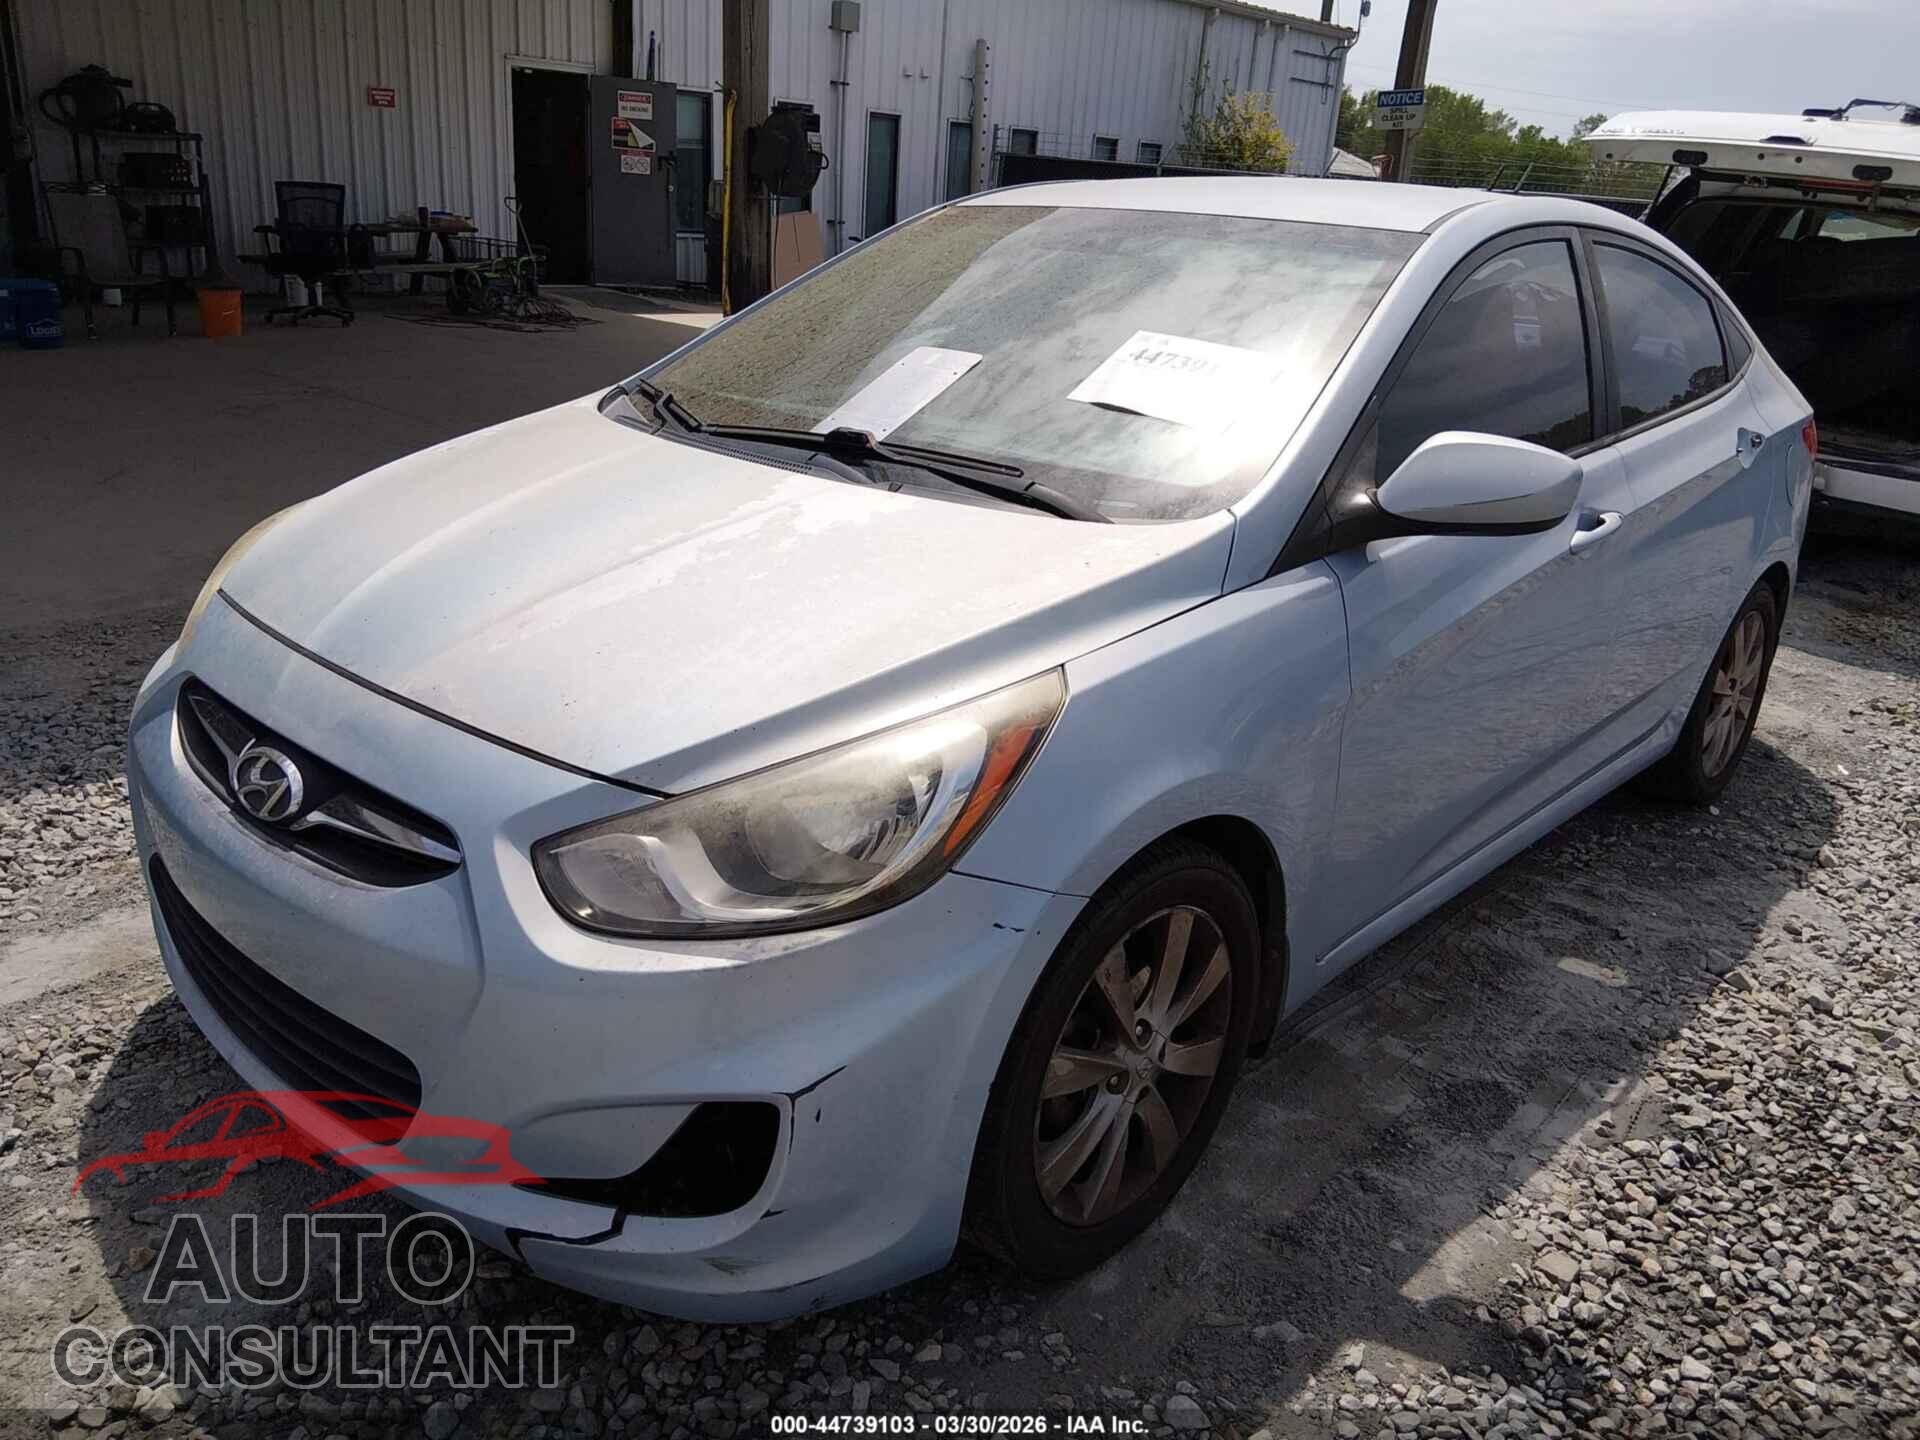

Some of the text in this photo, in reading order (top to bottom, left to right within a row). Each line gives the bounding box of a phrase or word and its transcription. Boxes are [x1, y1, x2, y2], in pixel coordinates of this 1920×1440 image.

[1380, 92, 1422, 105] NOTICE
[1381, 113, 1416, 121] CLEAN UP
